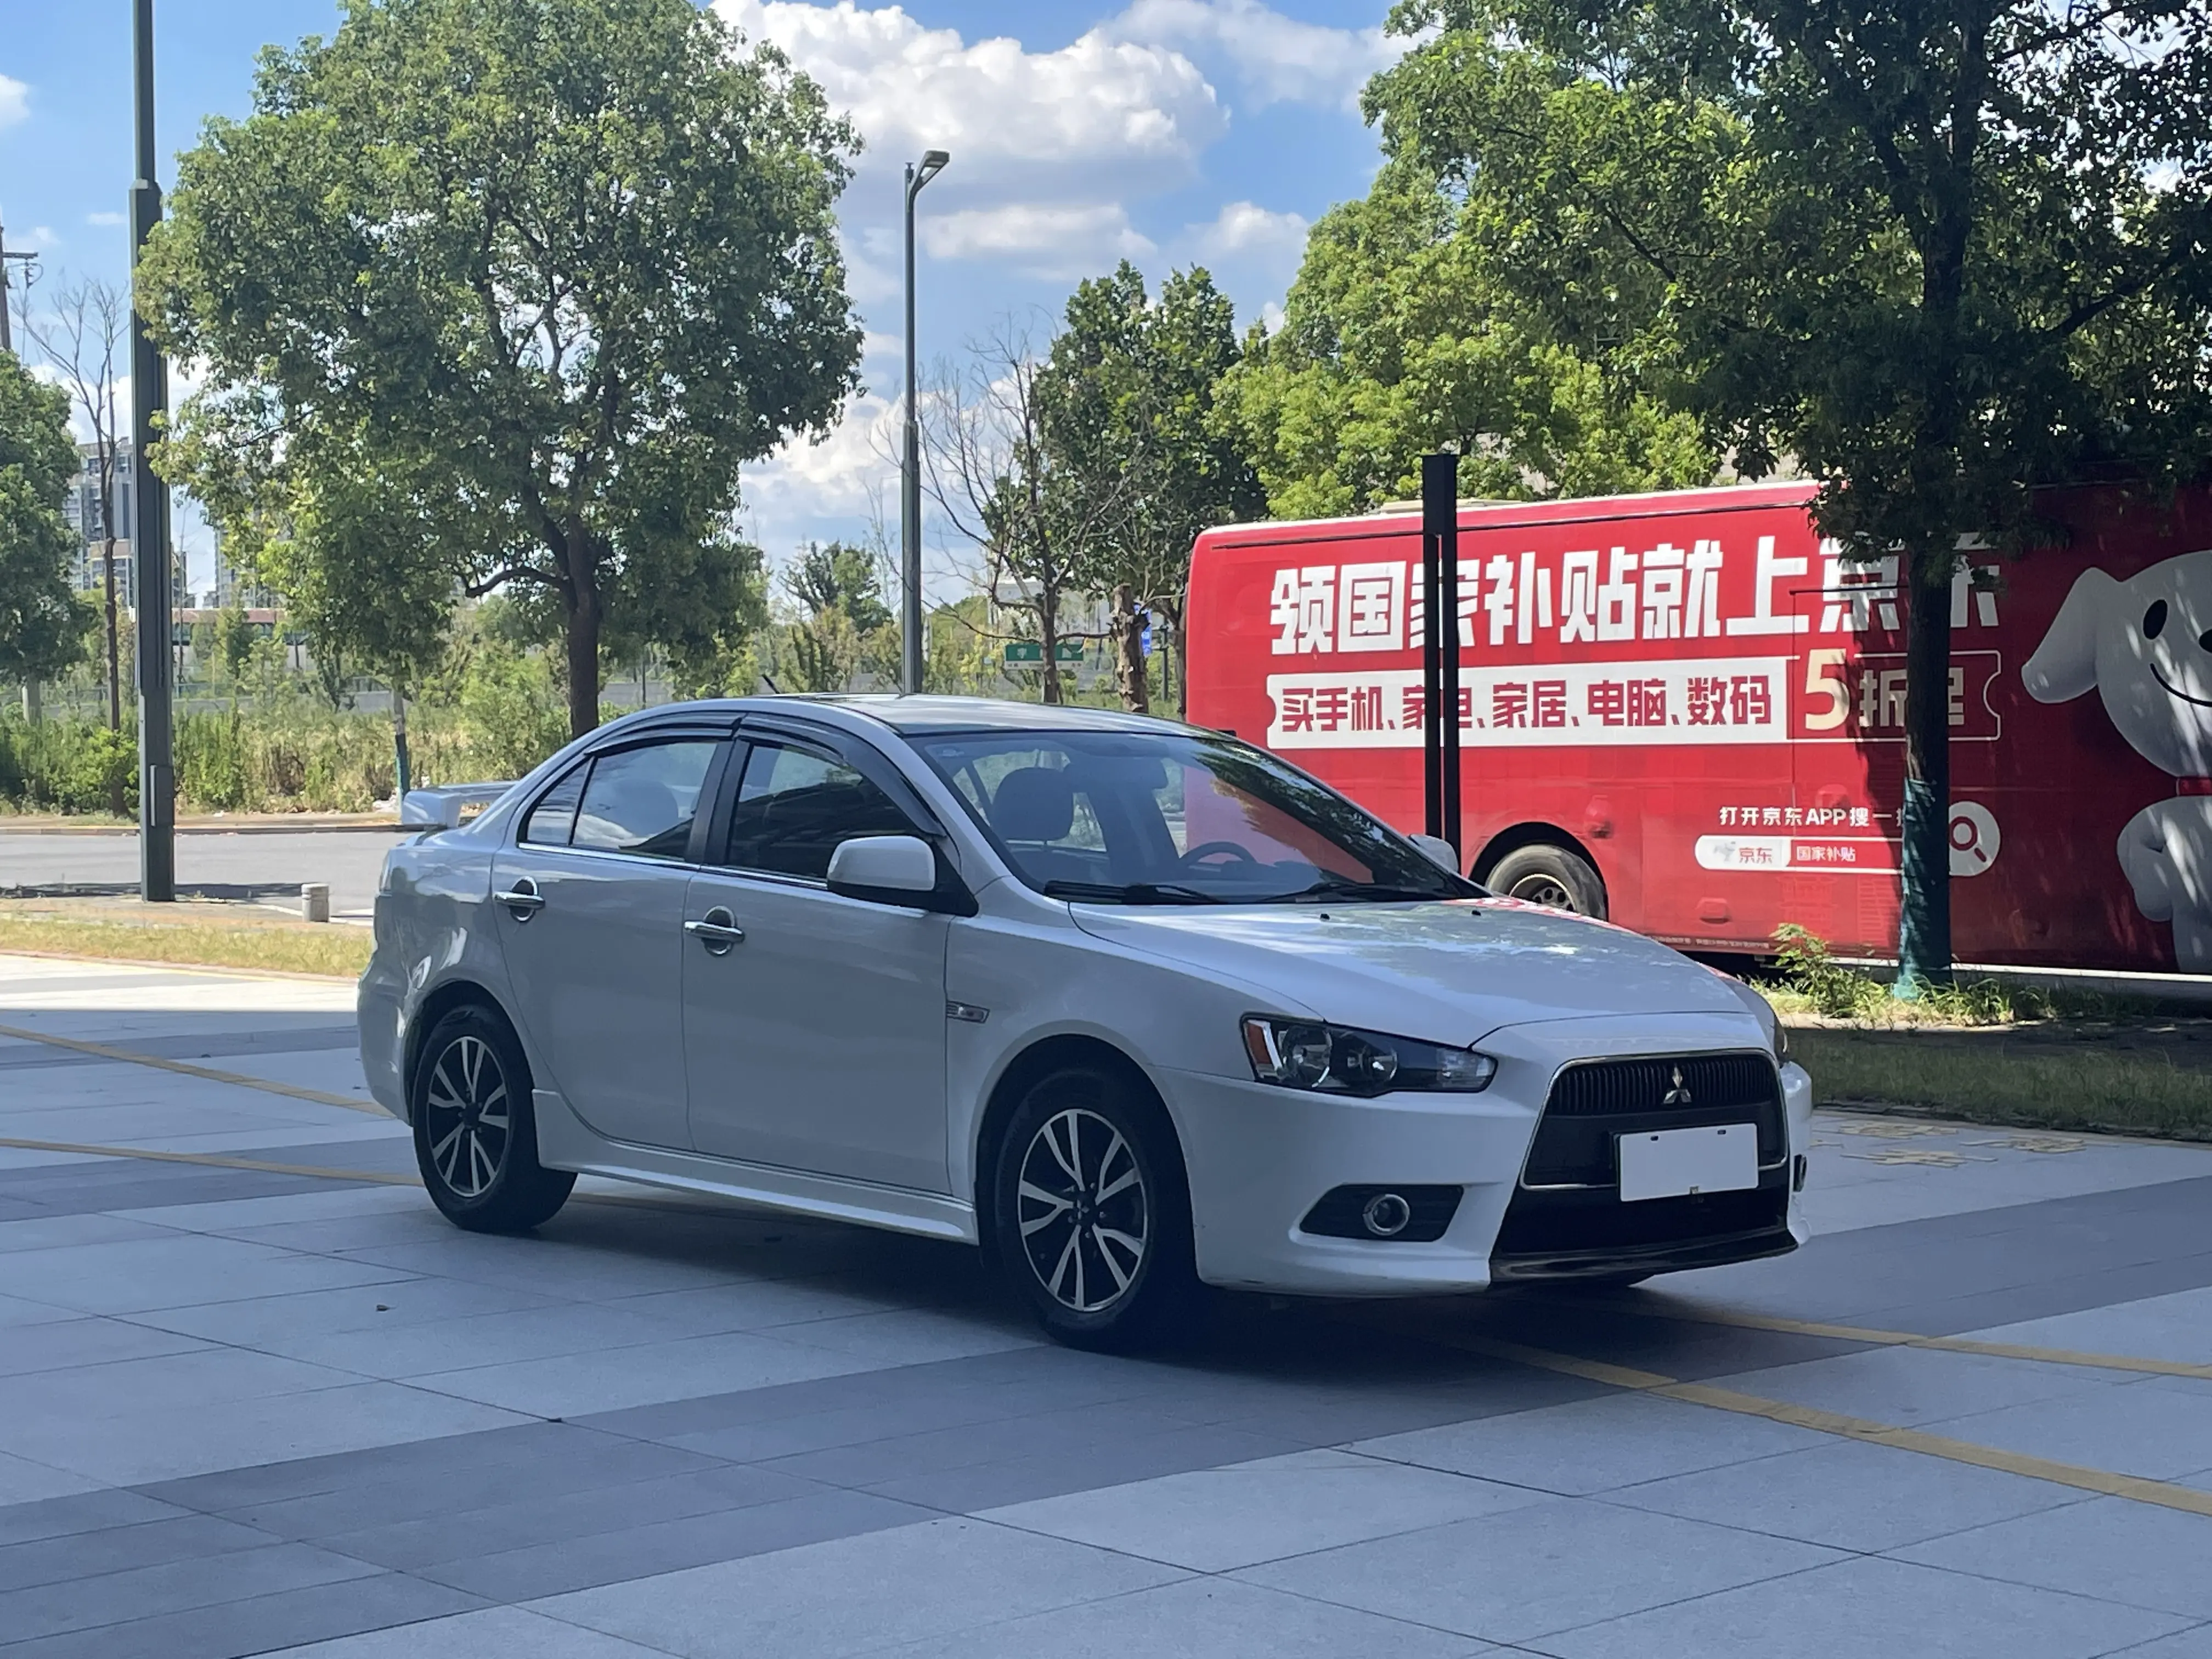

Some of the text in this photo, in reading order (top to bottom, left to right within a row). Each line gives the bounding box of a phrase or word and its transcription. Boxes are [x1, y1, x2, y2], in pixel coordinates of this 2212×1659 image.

[1269, 532, 2000, 655] 领国家补贴就上京
[1805, 648, 1965, 731] 5折
[1738, 847, 1774, 865] 京东
[1796, 845, 1857, 862] 国家补贴
